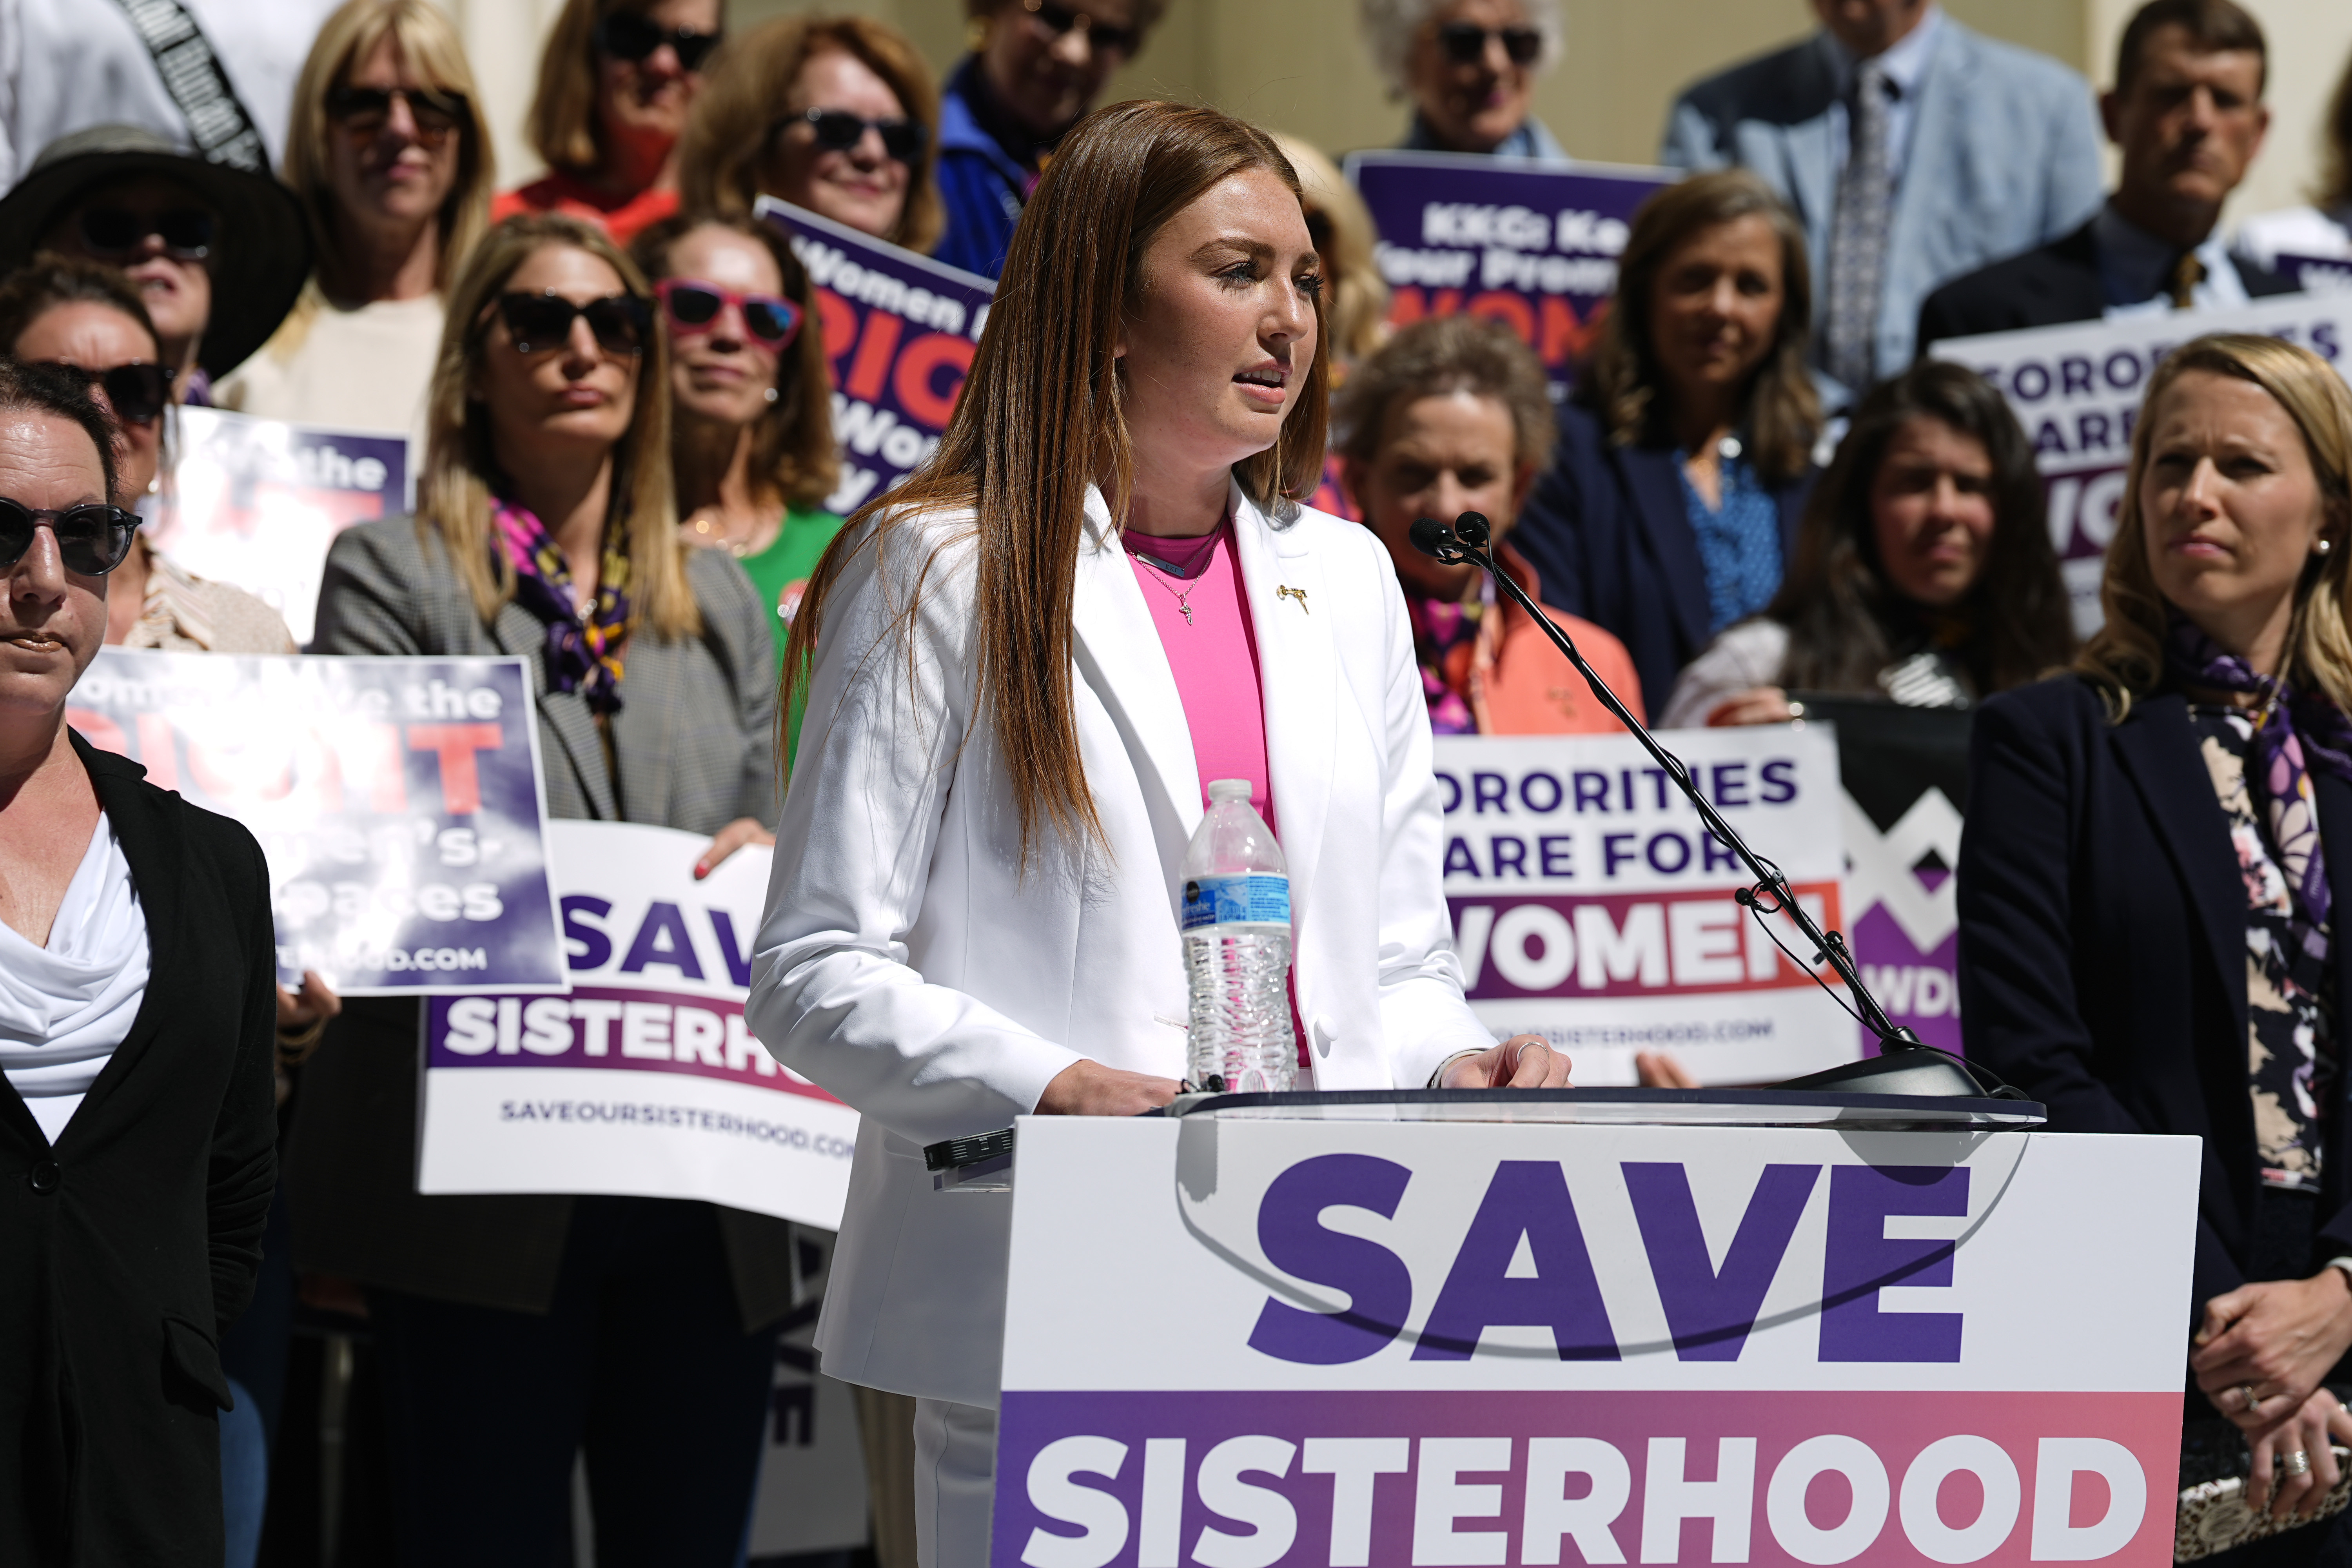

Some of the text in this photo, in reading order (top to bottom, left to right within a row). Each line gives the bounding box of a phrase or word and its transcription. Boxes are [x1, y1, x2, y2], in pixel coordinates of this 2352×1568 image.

[789, 236, 965, 336] Women
[814, 286, 977, 429] RIG
[410, 679, 503, 719] the
[1433, 760, 1797, 814] ORORITIES
[1443, 835, 1574, 878] ARE
[558, 895, 761, 989] SAV
[1456, 892, 1831, 992] OMEN
[444, 996, 821, 1087] SISTERH
[1247, 1153, 1971, 1367] SAVE
[1020, 1434, 2147, 1568] SISTERHOOD
